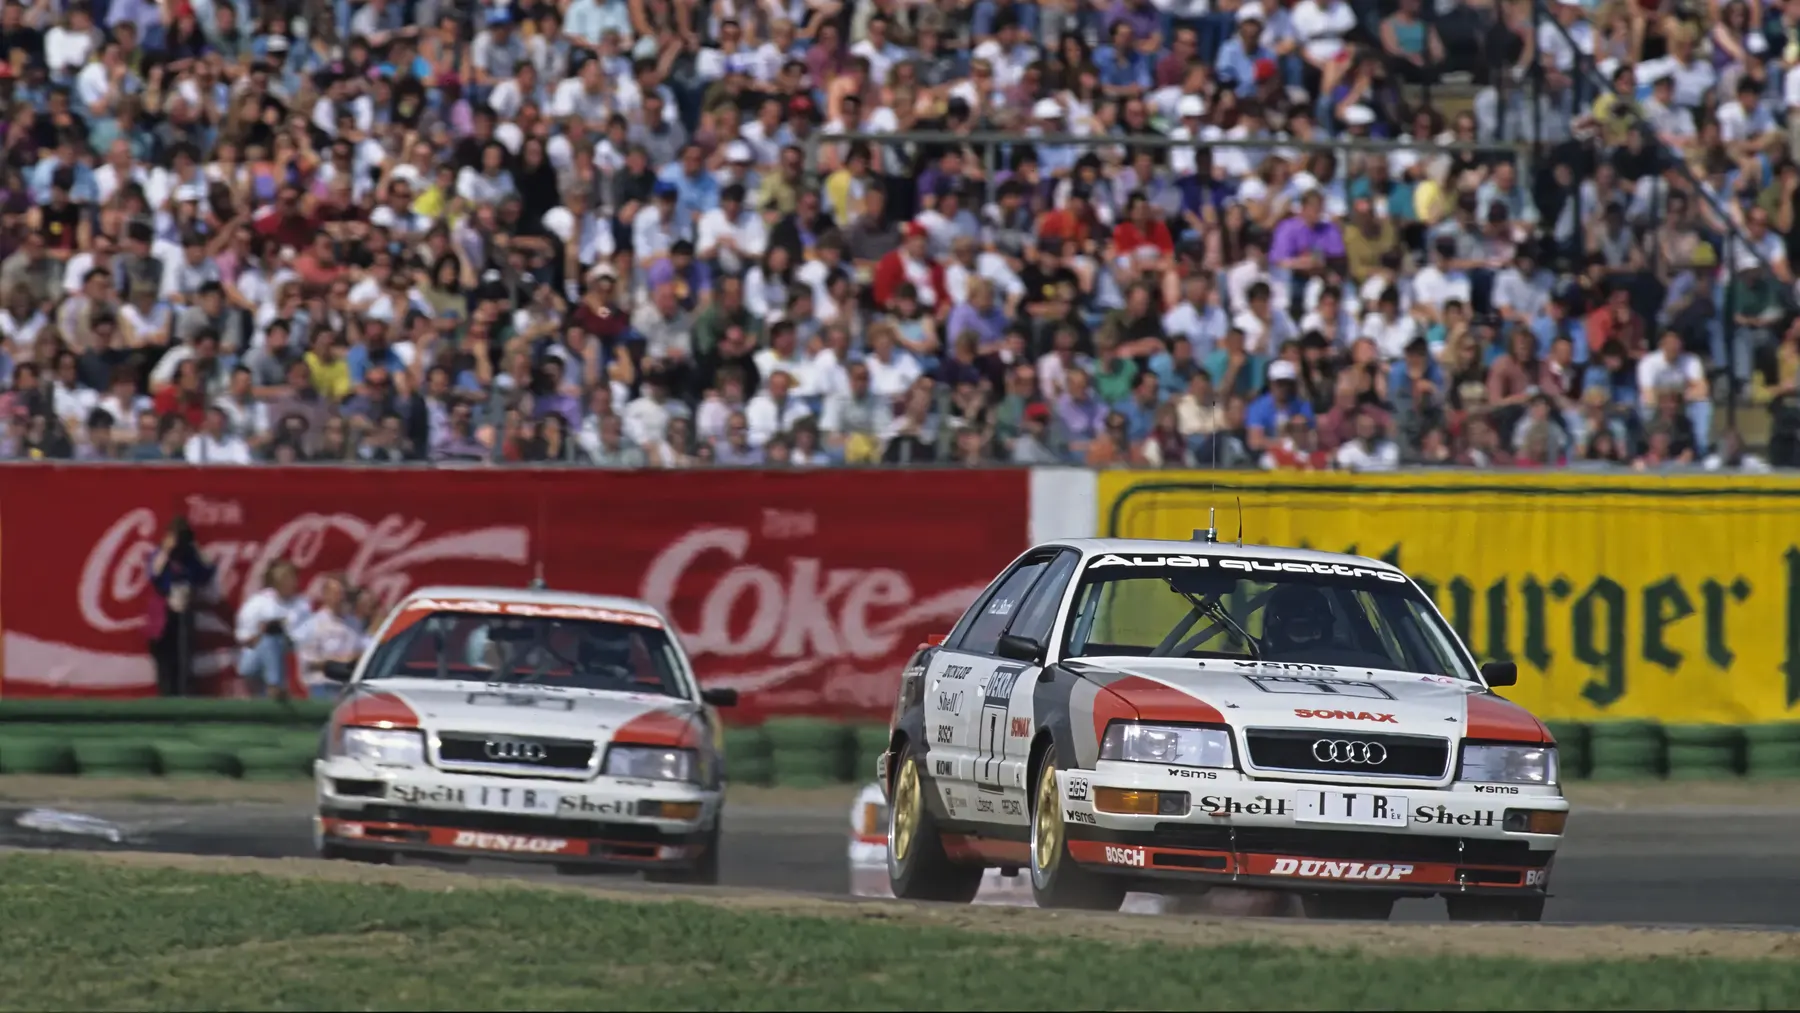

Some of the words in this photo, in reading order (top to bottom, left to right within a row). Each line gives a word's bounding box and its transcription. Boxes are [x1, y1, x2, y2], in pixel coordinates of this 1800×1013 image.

[1089, 554, 1210, 569] Audi
[1219, 559, 1406, 583] quattro
[641, 525, 913, 660] Coke
[937, 691, 958, 712] Shell
[1294, 708, 1398, 724] SONAX
[1180, 769, 1217, 780] sms
[392, 785, 464, 803] Shell
[1486, 785, 1519, 795] sms
[560, 795, 635, 816] Shell
[1200, 795, 1286, 815] Shell
[1414, 805, 1494, 826] Shell
[1074, 811, 1096, 824] sms
[453, 830, 568, 852] DUNLOP
[1105, 846, 1145, 867] BOSCH
[1270, 858, 1414, 881] DUNLOP
